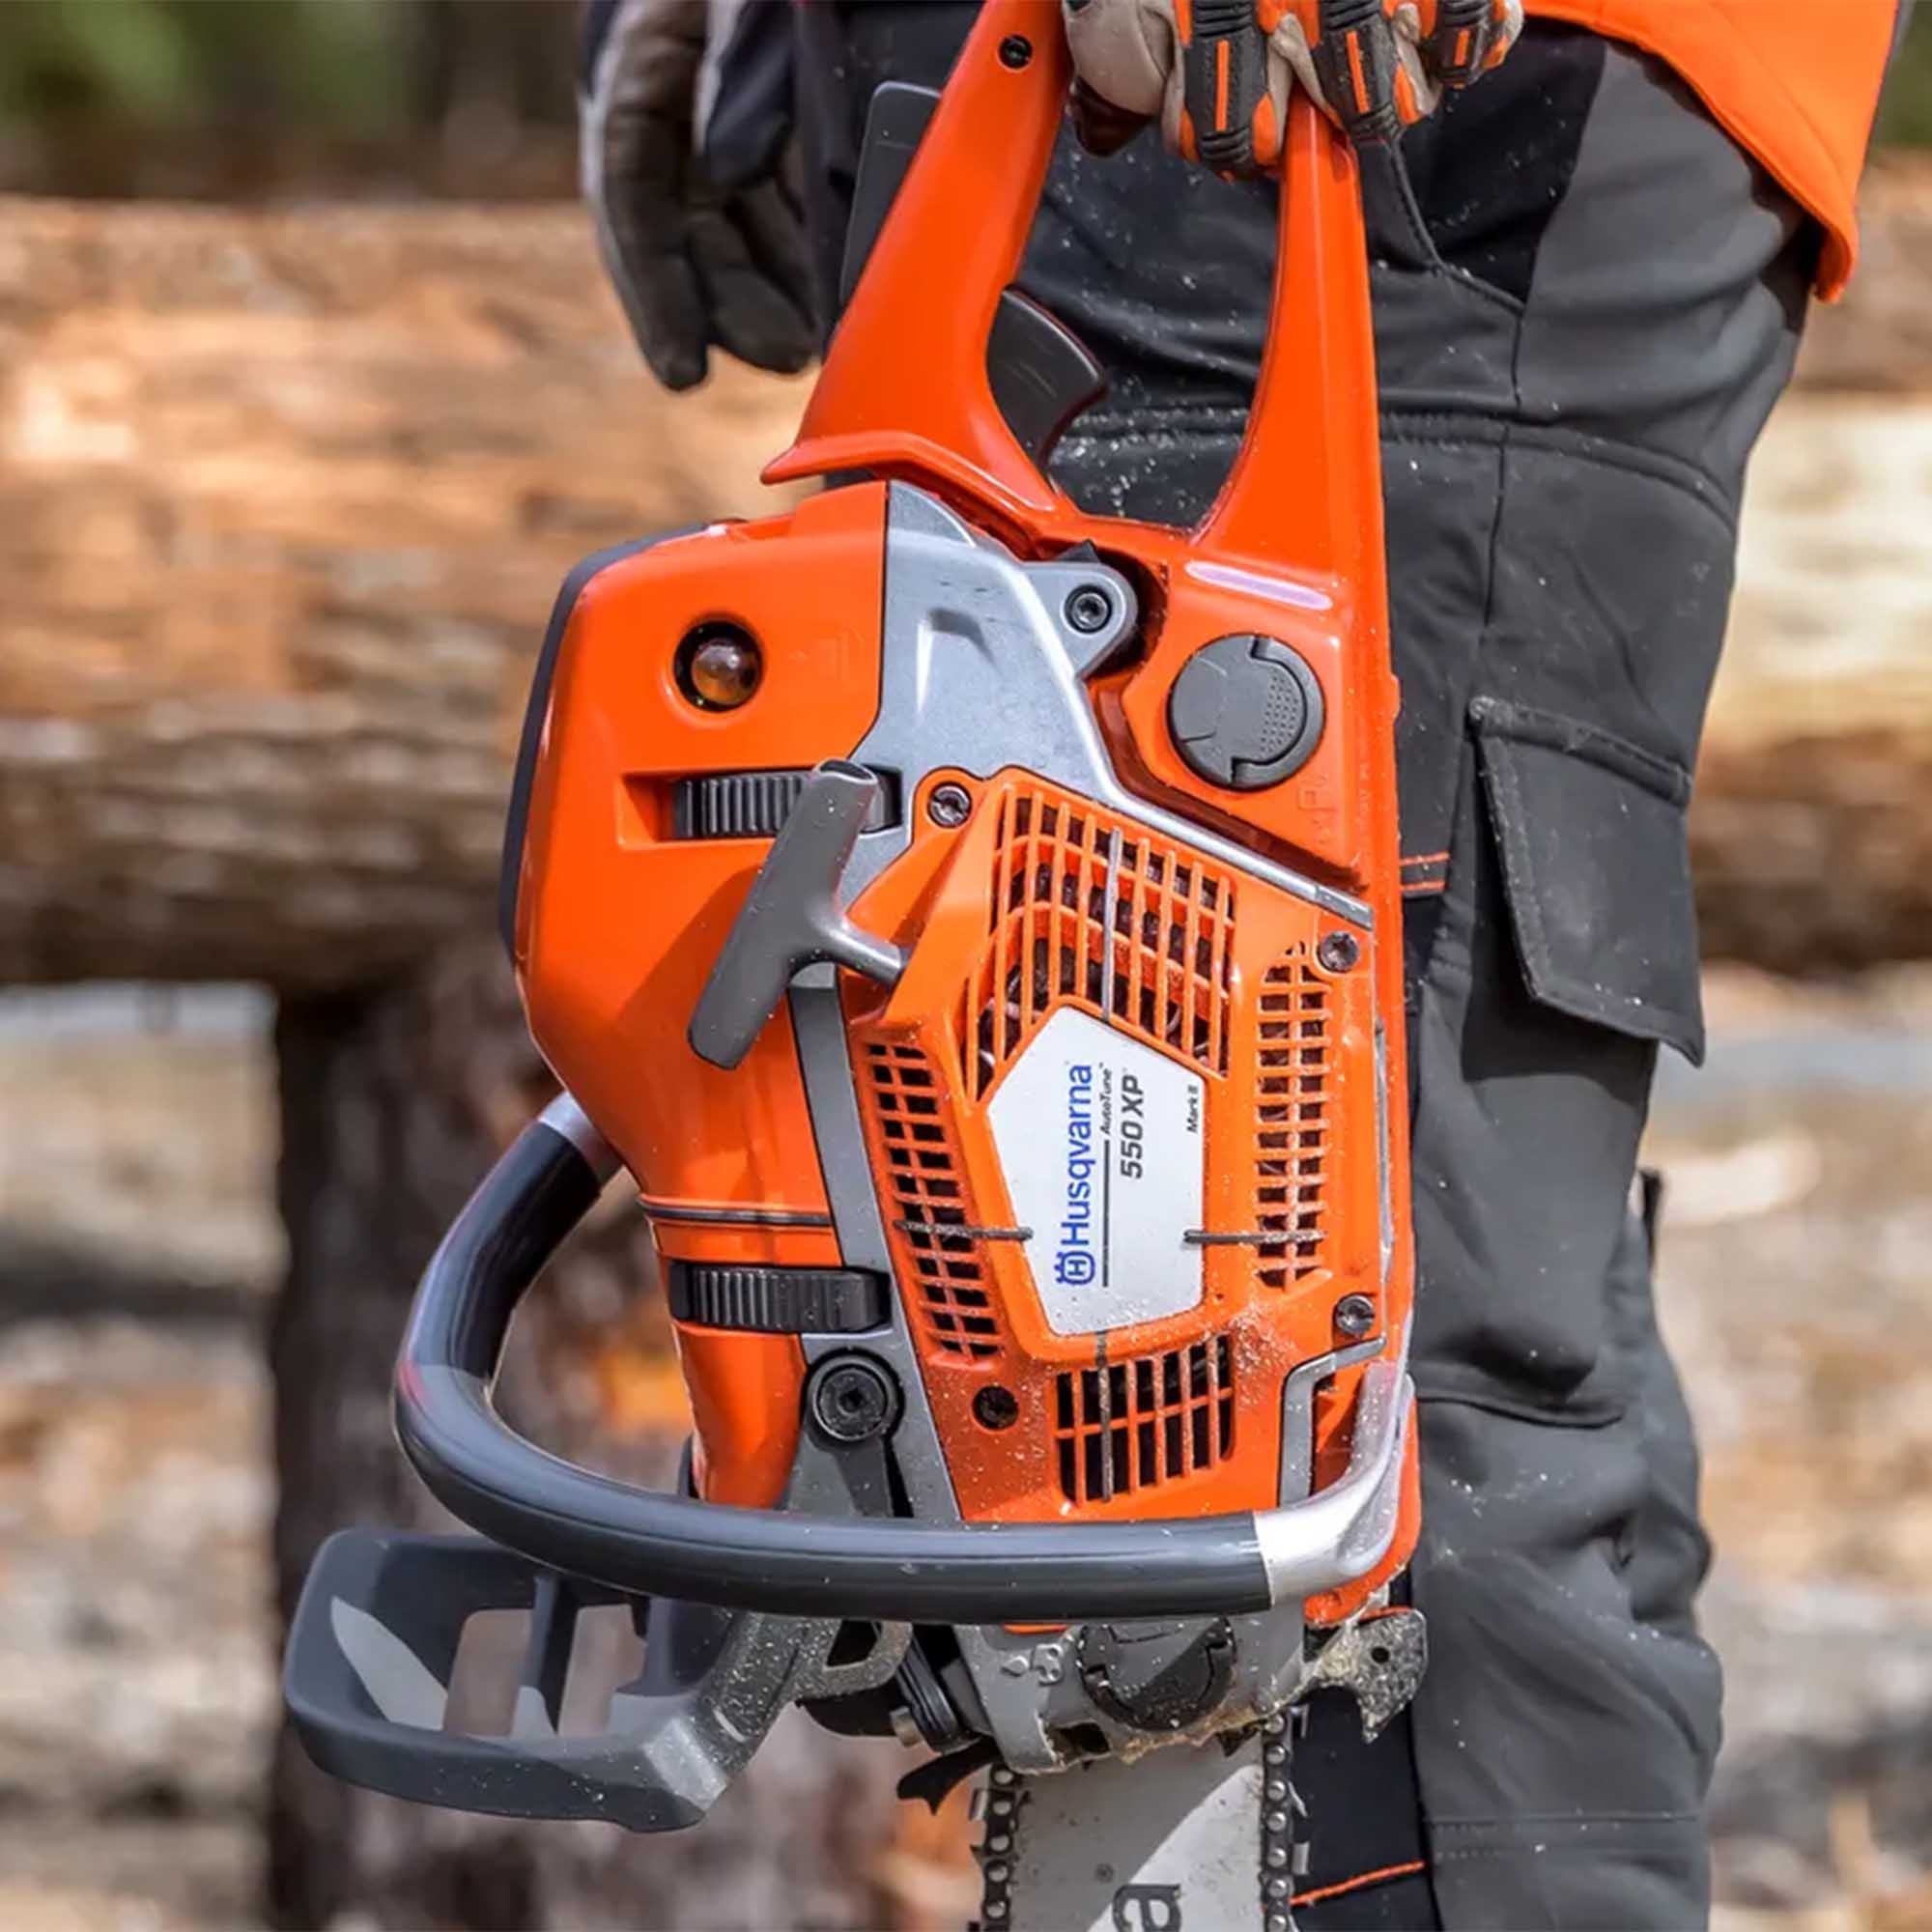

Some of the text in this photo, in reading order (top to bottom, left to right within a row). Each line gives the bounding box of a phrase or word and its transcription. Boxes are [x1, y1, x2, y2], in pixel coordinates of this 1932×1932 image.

[1060, 1065, 1096, 1246] Husqvarna
[1120, 1074, 1144, 1179] 550 XP
[1186, 1097, 1199, 1134] Mark
